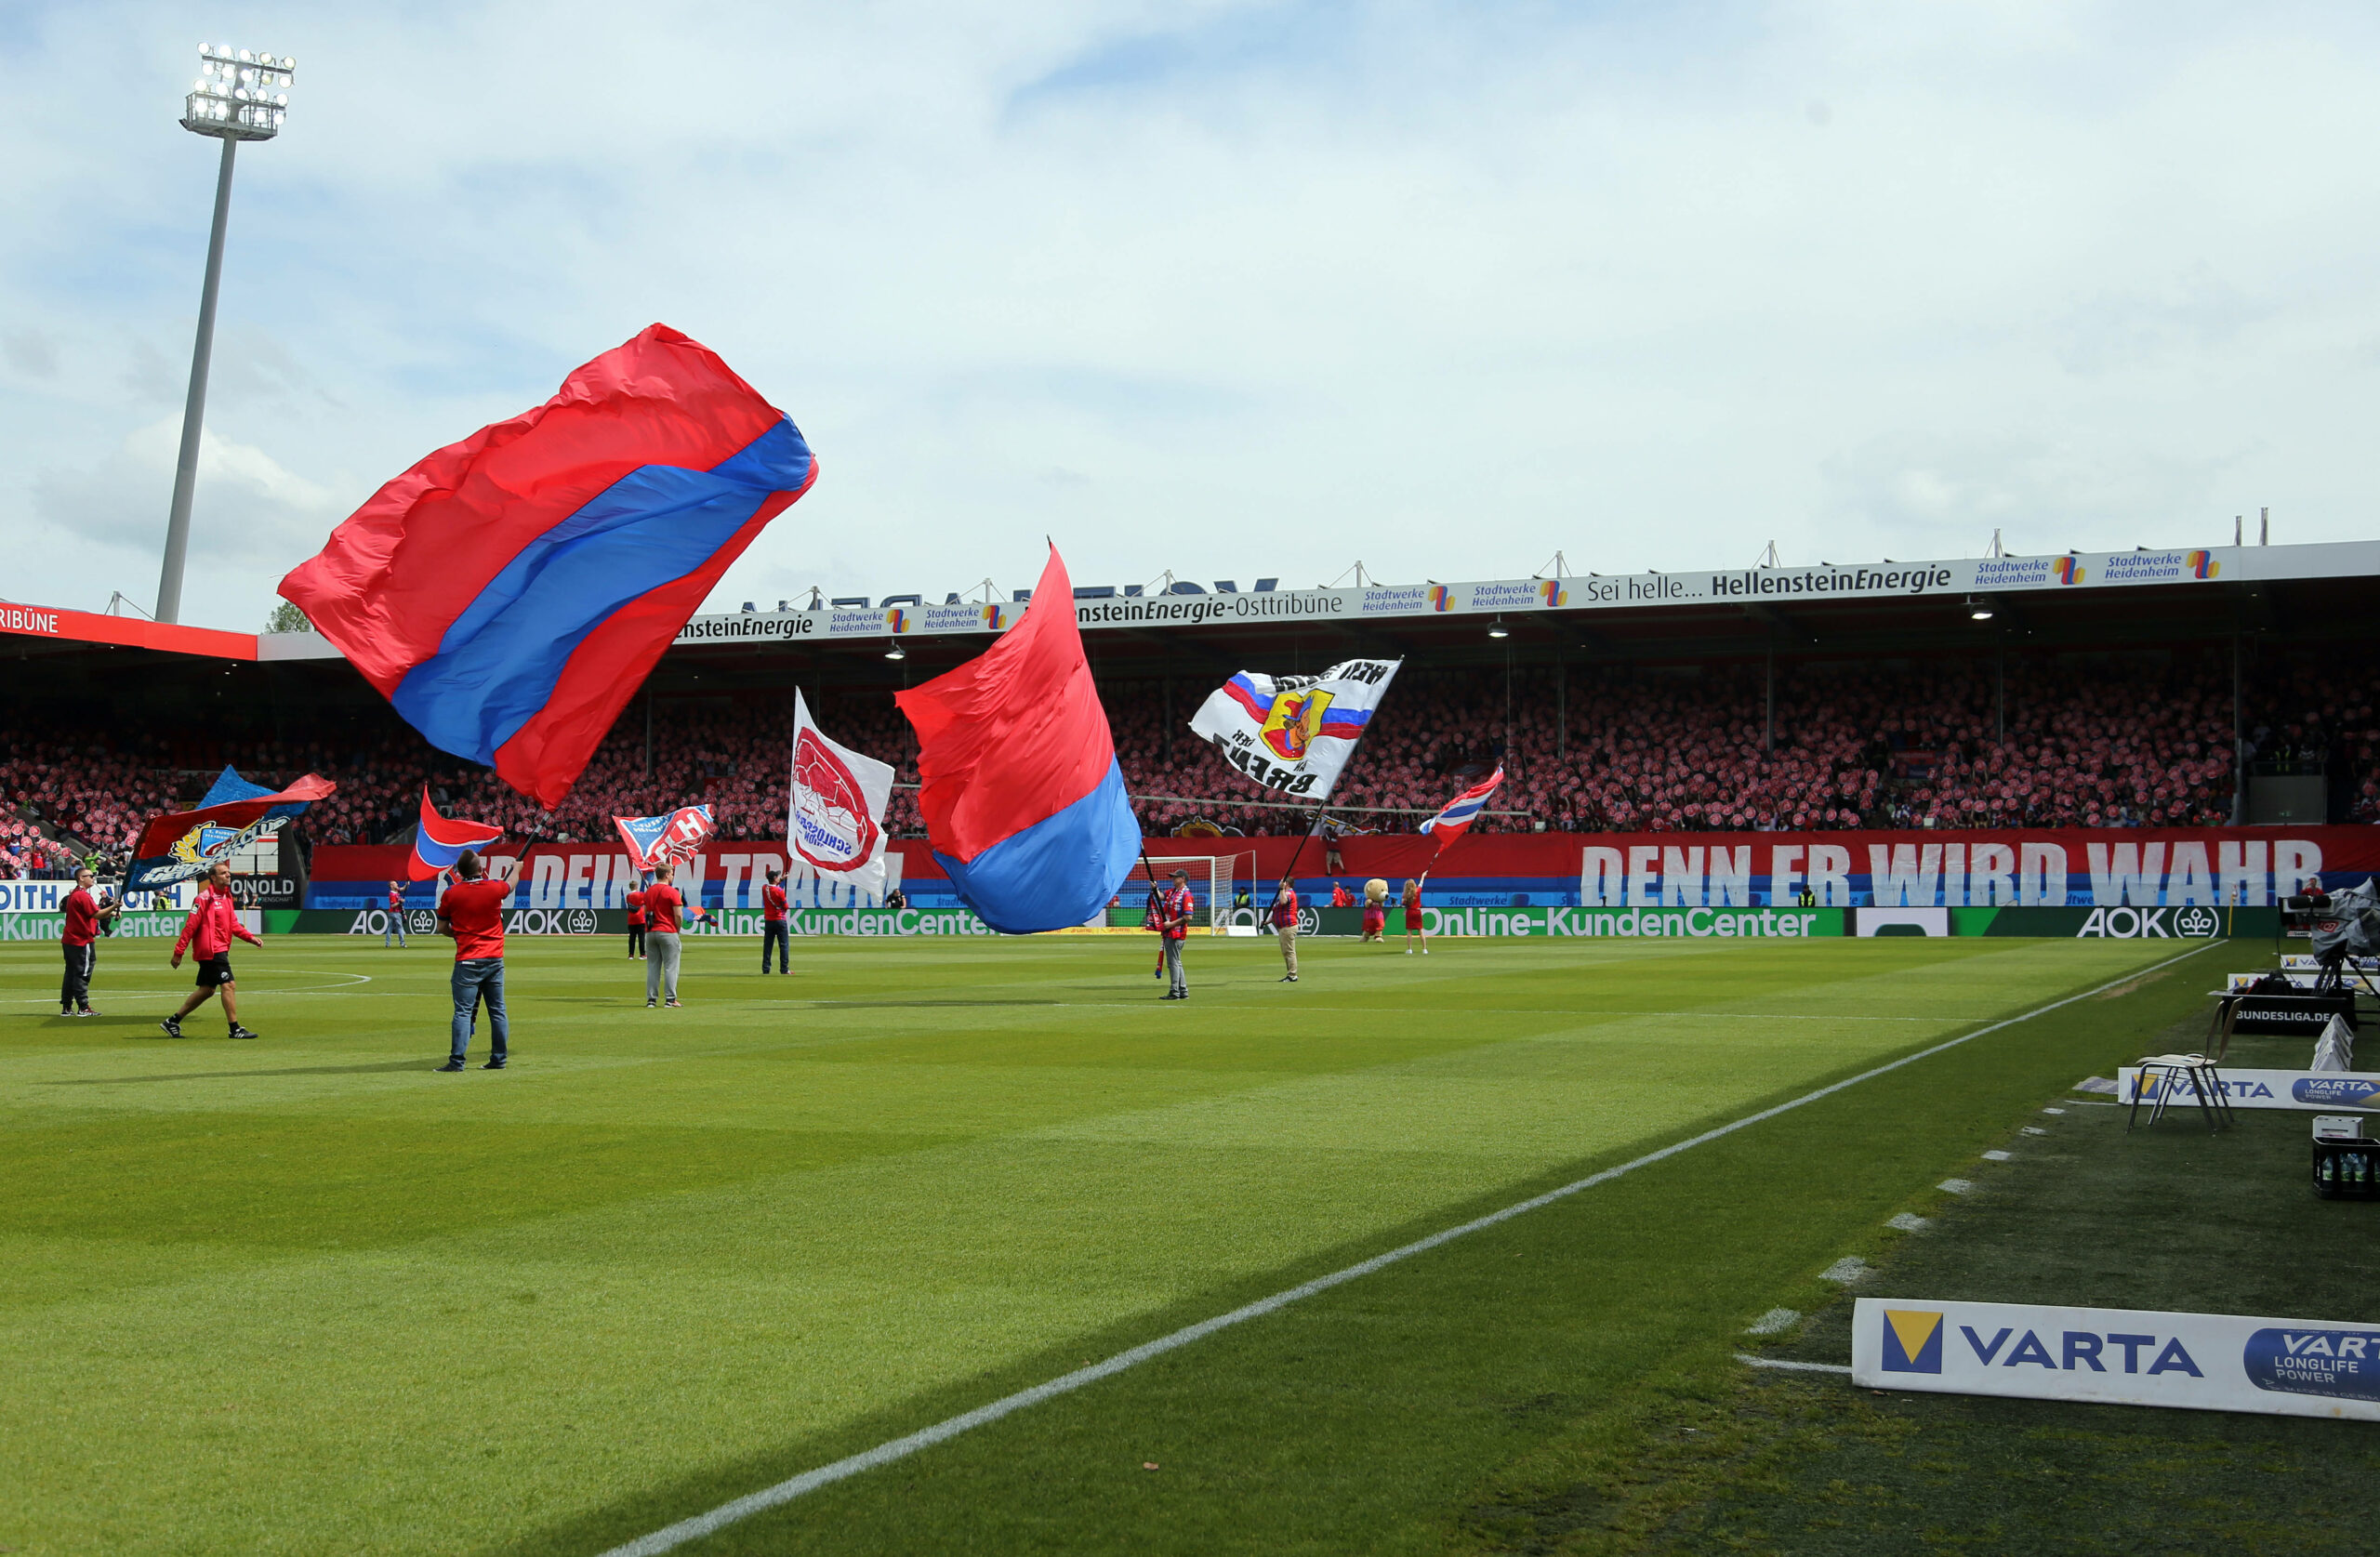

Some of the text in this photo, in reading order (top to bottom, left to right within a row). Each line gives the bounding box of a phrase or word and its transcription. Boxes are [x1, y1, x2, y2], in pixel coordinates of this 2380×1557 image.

[1978, 560, 2049, 573] Stadtwerke
[2109, 554, 2181, 567] Stadtwerke
[1976, 573, 2046, 585] Heidenheim
[2105, 567, 2178, 579] Heidenheim
[1588, 564, 1951, 601] Sei helle... HellensteinEnergie
[1365, 588, 1424, 600] Stadtwerke
[1474, 585, 1536, 596] Stadtwerke
[1075, 593, 1342, 623] nsteinEnergie-Osttribüne
[1362, 600, 1422, 612] Heidenheim
[1473, 596, 1534, 607] Heidenheim
[832, 613, 883, 623] Stadtwerke
[927, 609, 979, 619] Stadtwerke
[829, 623, 881, 633] Heidenheim
[924, 619, 977, 629] Heidenheim
[1580, 839, 2323, 907] DENN ER WIRD WAHR
[231, 879, 295, 894] ONOLD
[1449, 895, 1507, 905] Stadtwerke
[505, 909, 564, 934] AOK
[1215, 908, 1280, 935] AOK
[1423, 907, 1817, 937] Online-KundenCenter
[2076, 907, 2167, 938] AOK
[2237, 1010, 2330, 1023] BUNDESLIGA.DE
[2173, 1079, 2274, 1098] VARTA
[2308, 1080, 2373, 1092] VARTA
[1959, 1325, 2204, 1379] VARTA
[2274, 1356, 2359, 1373] LONGLIFE
[2276, 1369, 2335, 1384] POWER
